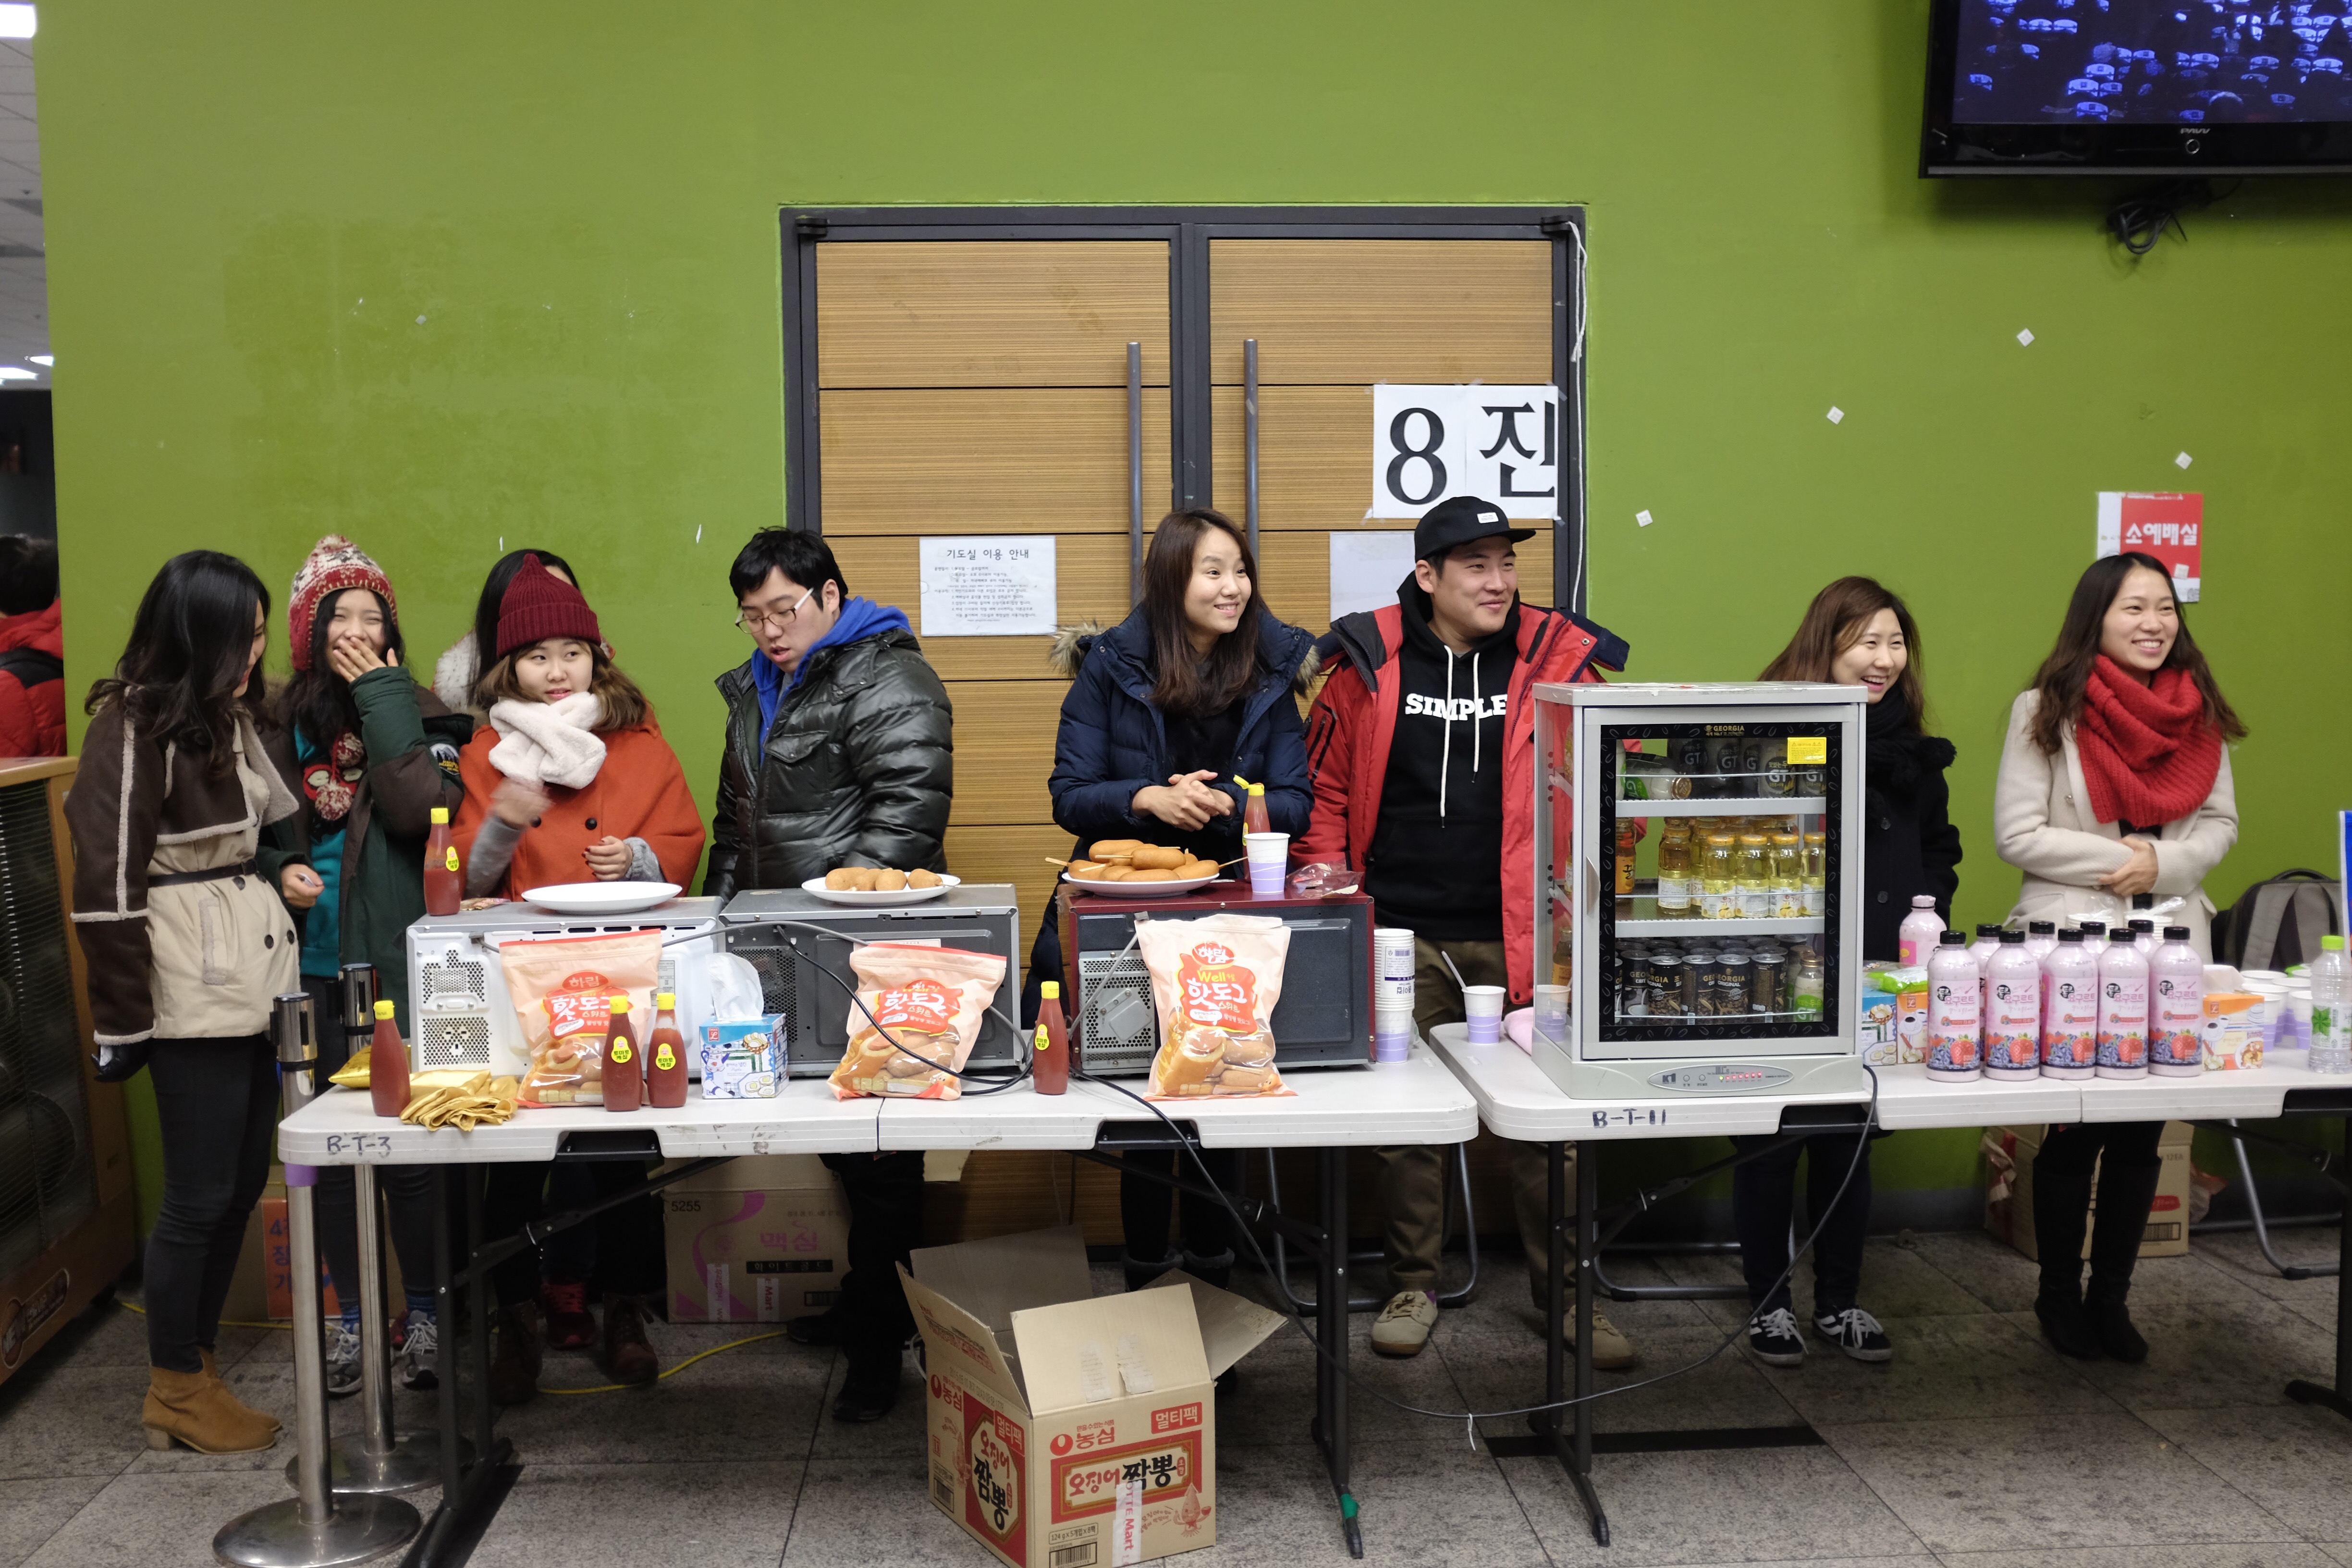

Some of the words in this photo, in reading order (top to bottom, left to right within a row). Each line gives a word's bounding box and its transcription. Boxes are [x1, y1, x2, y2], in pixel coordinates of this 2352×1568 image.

[2125, 523, 2198, 546] 소예배실
[946, 549, 976, 560] 기도실
[983, 549, 1003, 561] 이용
[1009, 549, 1029, 560] 안내
[1405, 693, 1507, 721] SIMPLE
[1746, 757, 1758, 770] G
[1769, 769, 1789, 783] GT
[569, 976, 600, 988] 하림
[1197, 970, 1226, 982] Well
[1717, 974, 1746, 982] EORGIA
[882, 990, 947, 1015] 핫도그
[1186, 977, 1248, 1010] 핫도그
[1944, 995, 1975, 1006] 요구르트
[2004, 994, 2034, 1005] 요구르트
[2067, 993, 2096, 1003] 요구르트
[2114, 993, 2144, 1003] 요구르트
[2166, 991, 2198, 1001] 요구르트
[671, 1201, 701, 1212] 5255
[760, 1231, 818, 1252] 맥심
[943, 1382, 962, 1412] 농심
[1155, 1406, 1198, 1430] 멀티팩
[997, 1415, 1023, 1450] 멀티팩
[1076, 1427, 1115, 1450] 농심
[980, 1430, 1010, 1480] 오징어
[974, 1453, 1009, 1531] 짬뽕
[1069, 1468, 1120, 1497] 오징어
[1125, 1482, 1134, 1516] OTTE
[1125, 1518, 1135, 1551] Mart
